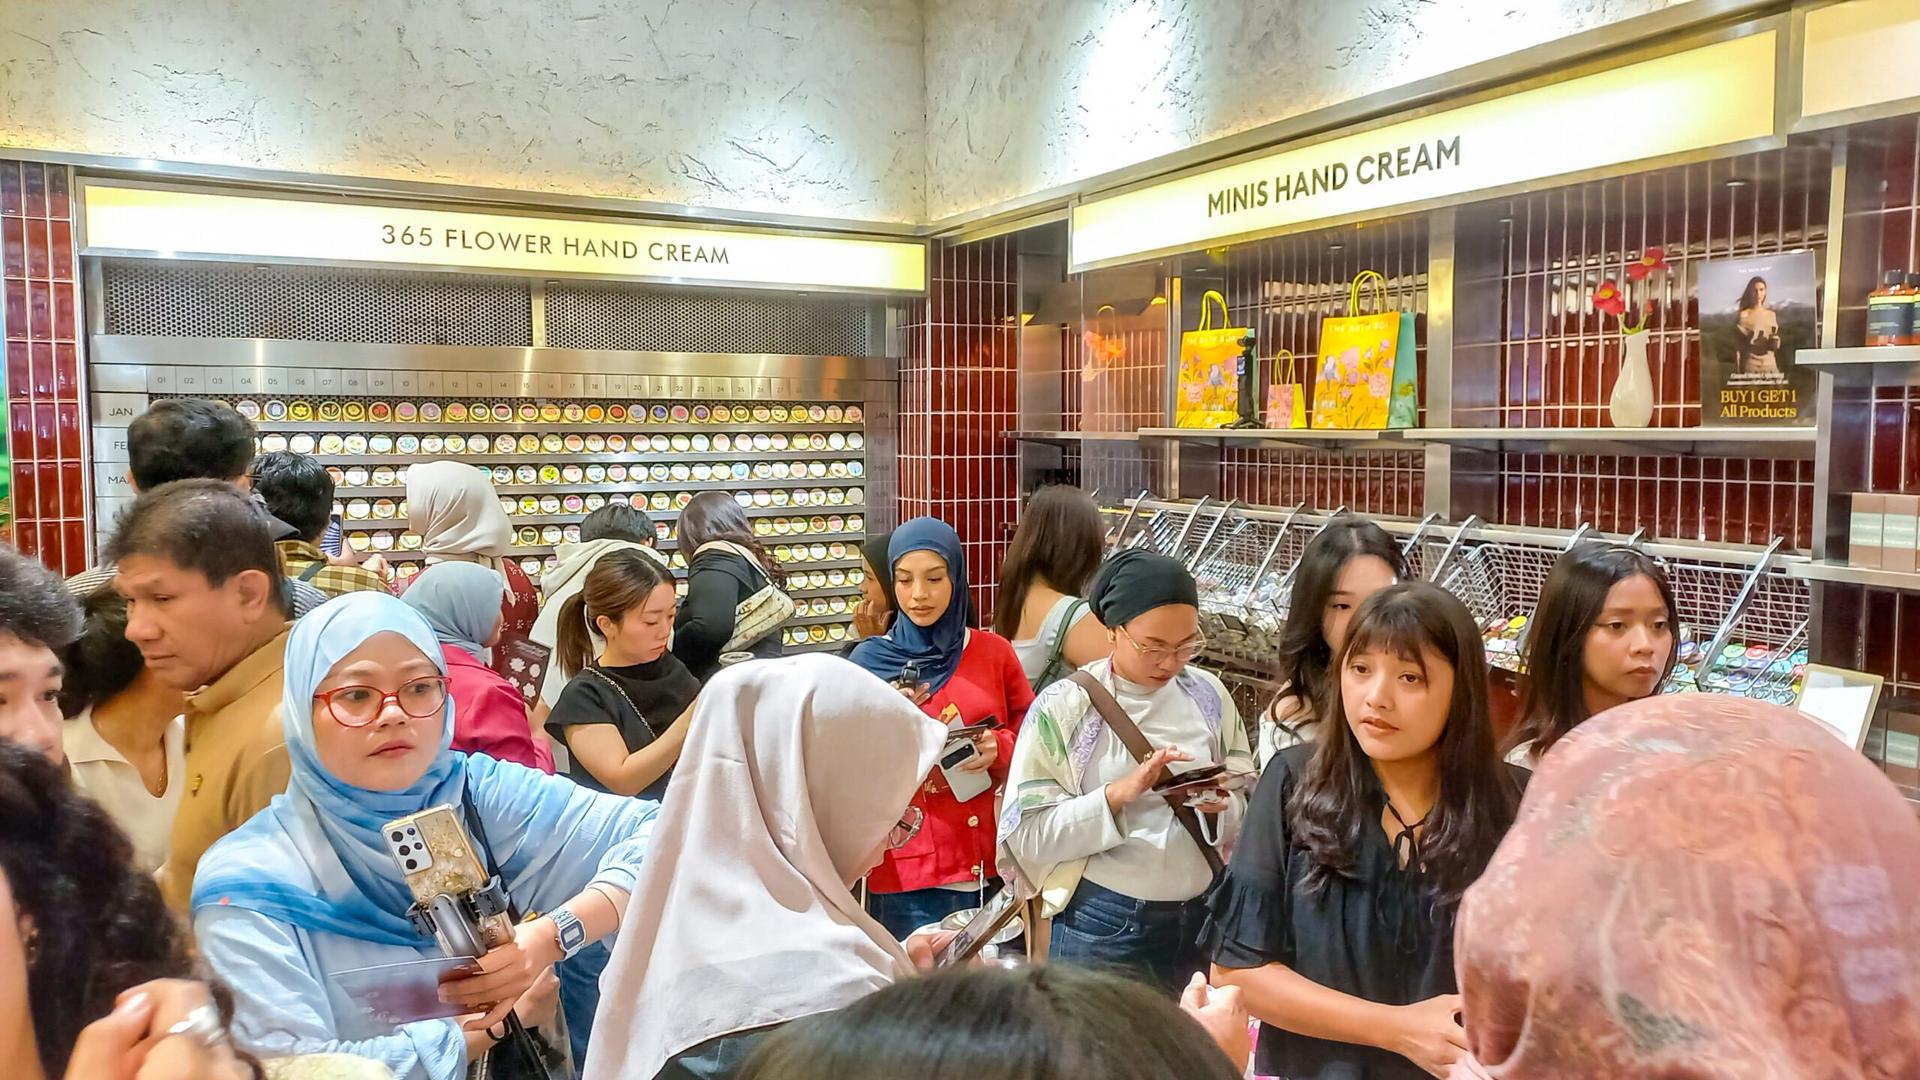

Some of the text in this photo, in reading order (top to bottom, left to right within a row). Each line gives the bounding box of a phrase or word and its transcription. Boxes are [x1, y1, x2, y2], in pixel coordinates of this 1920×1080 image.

[1208, 135, 1461, 218] MINIS HAND CREAM
[381, 224, 730, 265] 365 FLOWER HAND CREAM
[240, 377, 251, 385] 04
[1720, 389, 1797, 403] BUY 1 GET 1
[108, 408, 133, 416] JAN
[1720, 404, 1798, 418] All Products
[114, 441, 128, 449] FE
[108, 476, 129, 484] MA
